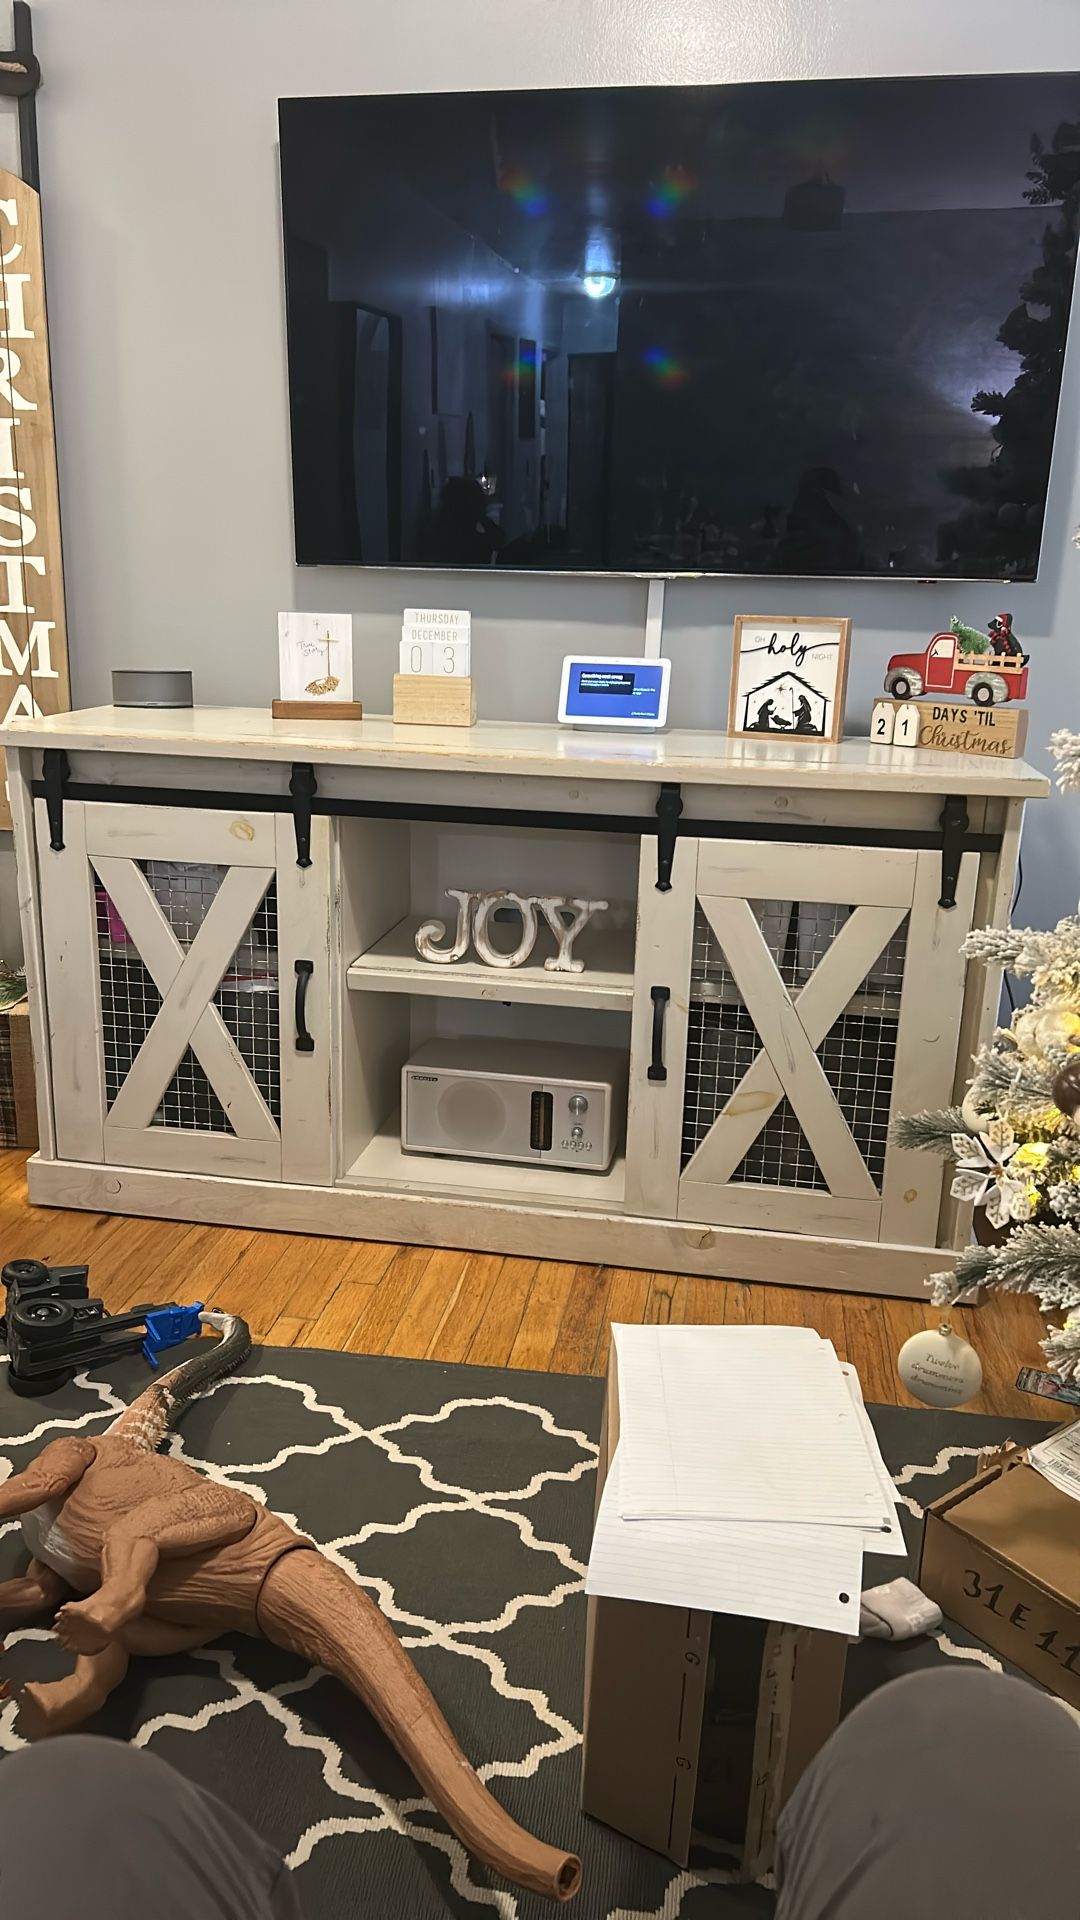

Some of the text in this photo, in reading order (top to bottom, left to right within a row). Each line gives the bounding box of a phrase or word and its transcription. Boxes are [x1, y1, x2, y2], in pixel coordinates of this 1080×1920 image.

[0, 199, 59, 801] RISTMA
[415, 612, 459, 625] THURSDAY
[411, 629, 458, 641] DECEMBER
[932, 706, 968, 724] DAYS
[919, 724, 1013, 755] Christmas
[415, 888, 609, 973] JOY
